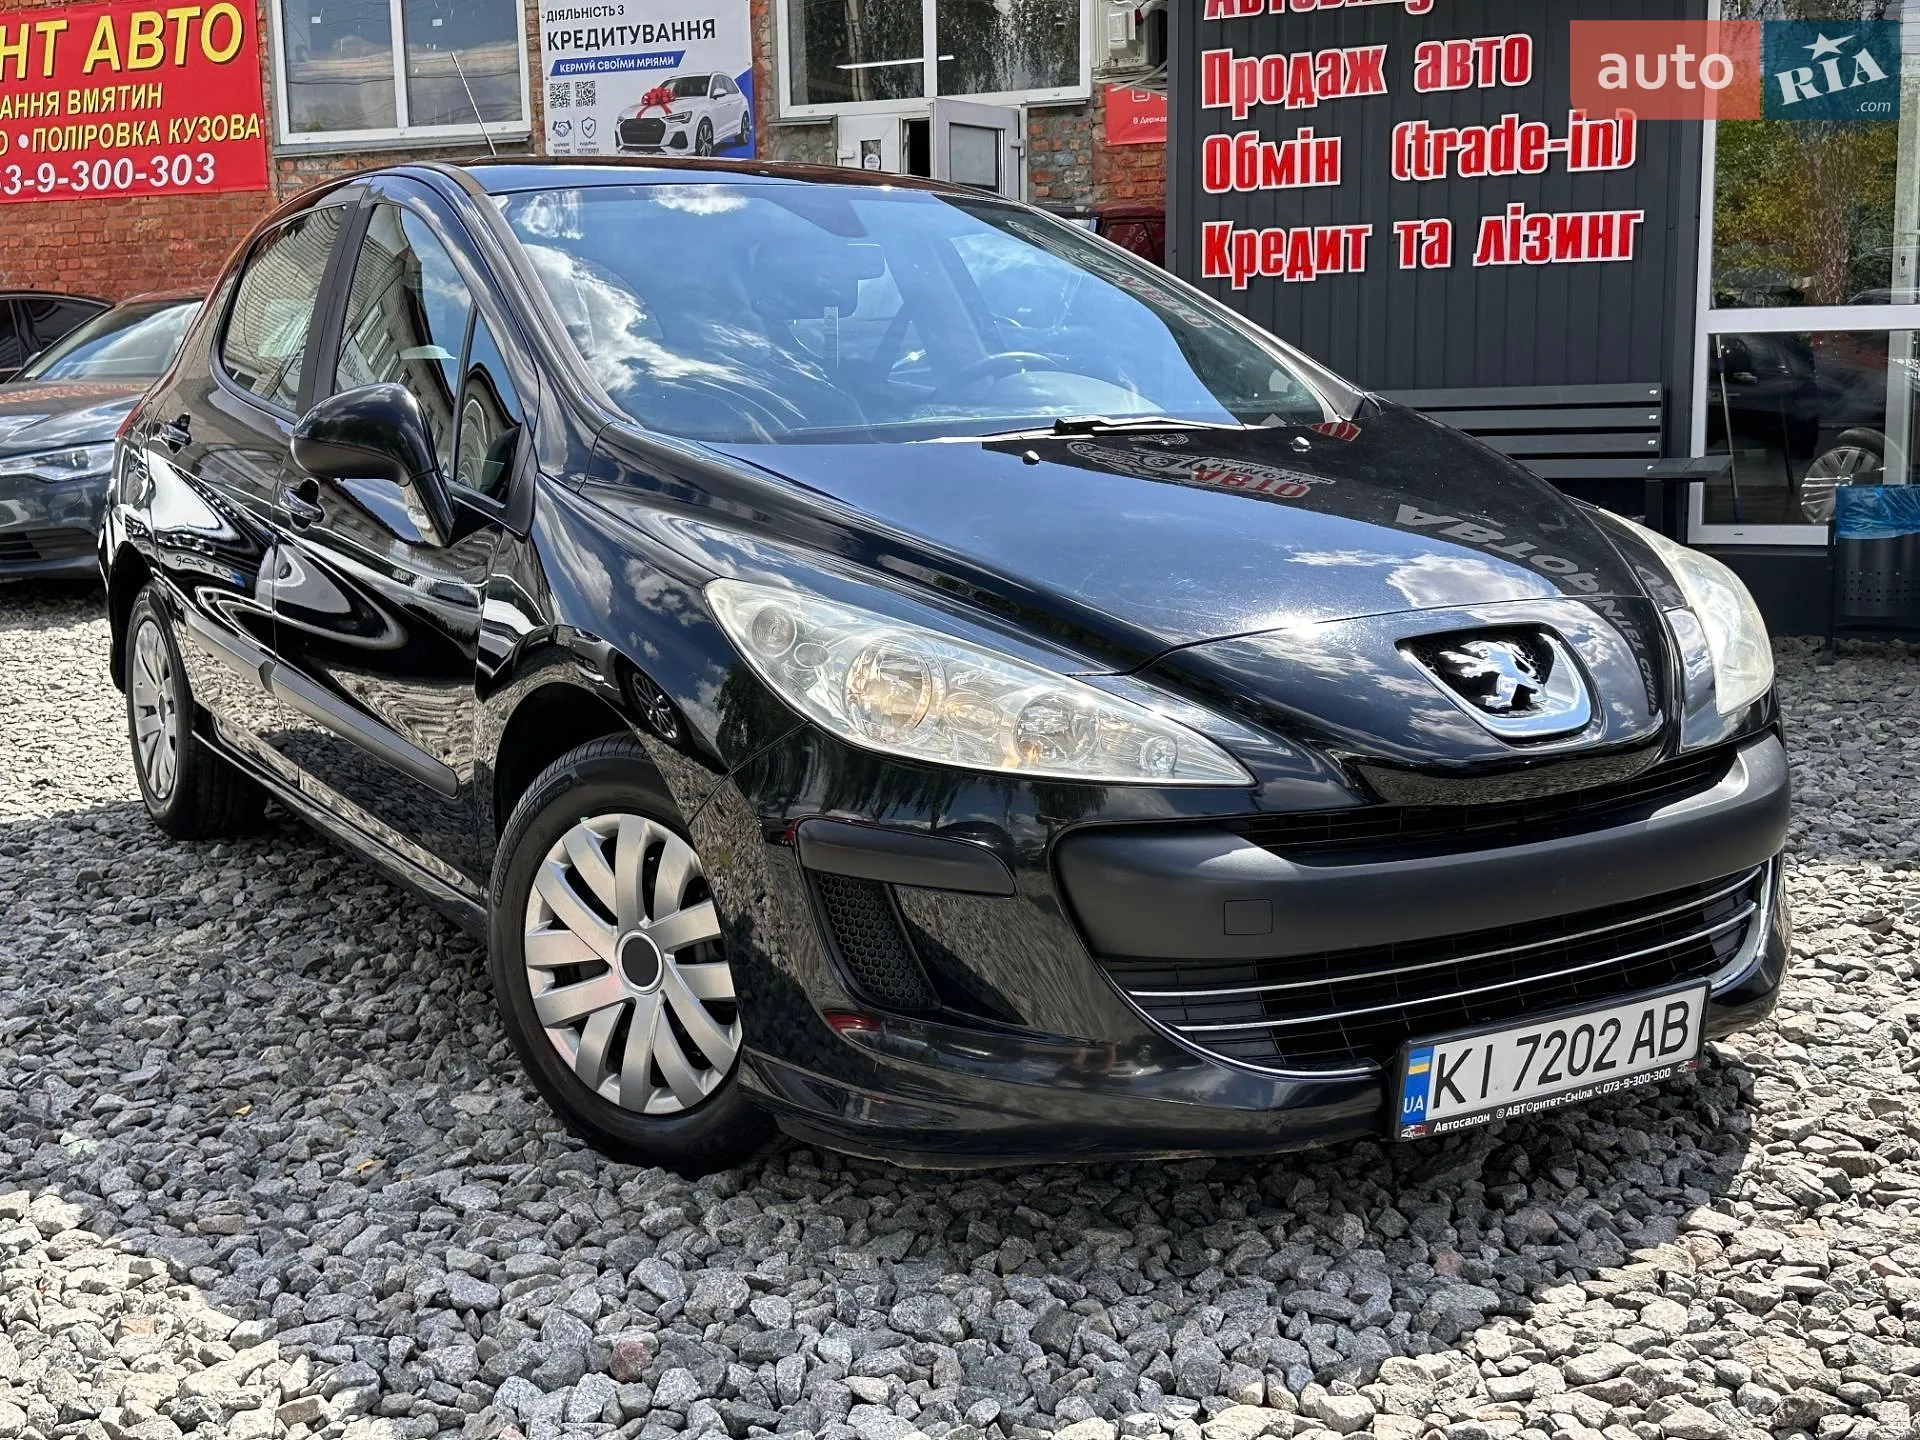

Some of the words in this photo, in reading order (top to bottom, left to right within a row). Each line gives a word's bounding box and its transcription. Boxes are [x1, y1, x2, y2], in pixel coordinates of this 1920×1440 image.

[546, 5, 615, 24] ДІЯЛЬНІСТЬ
[547, 18, 716, 51] КРЕДИТУВАННЯ
[82, 2, 243, 74] АВТО
[559, 60, 596, 73] КЕРМУЙ
[598, 57, 635, 71] СВОЇМИ
[637, 55, 675, 69] МРІЯМИ
[1201, 45, 1388, 120] Продаж
[1413, 33, 1533, 93] авто
[66, 82, 164, 115] ВМЯТИН
[32, 119, 162, 153] ПОЛІРОВКА
[168, 112, 262, 145] КУЗОВА
[1202, 127, 1342, 193] Обмін
[1391, 108, 1637, 181] (trade-in)
[0, 152, 215, 195] 3-9-300-303
[1201, 221, 1373, 290] Кредит
[1394, 218, 1452, 270] та
[1473, 202, 1645, 266] лізинг
[1432, 1045, 1494, 1110] KI
[1511, 1018, 1622, 1092] 7202
[1627, 1000, 1689, 1065] AB
[1403, 1095, 1424, 1114] UA
[1434, 1113, 1490, 1133] Автосалон
[1603, 1067, 1671, 1094] 073-9-300-300
